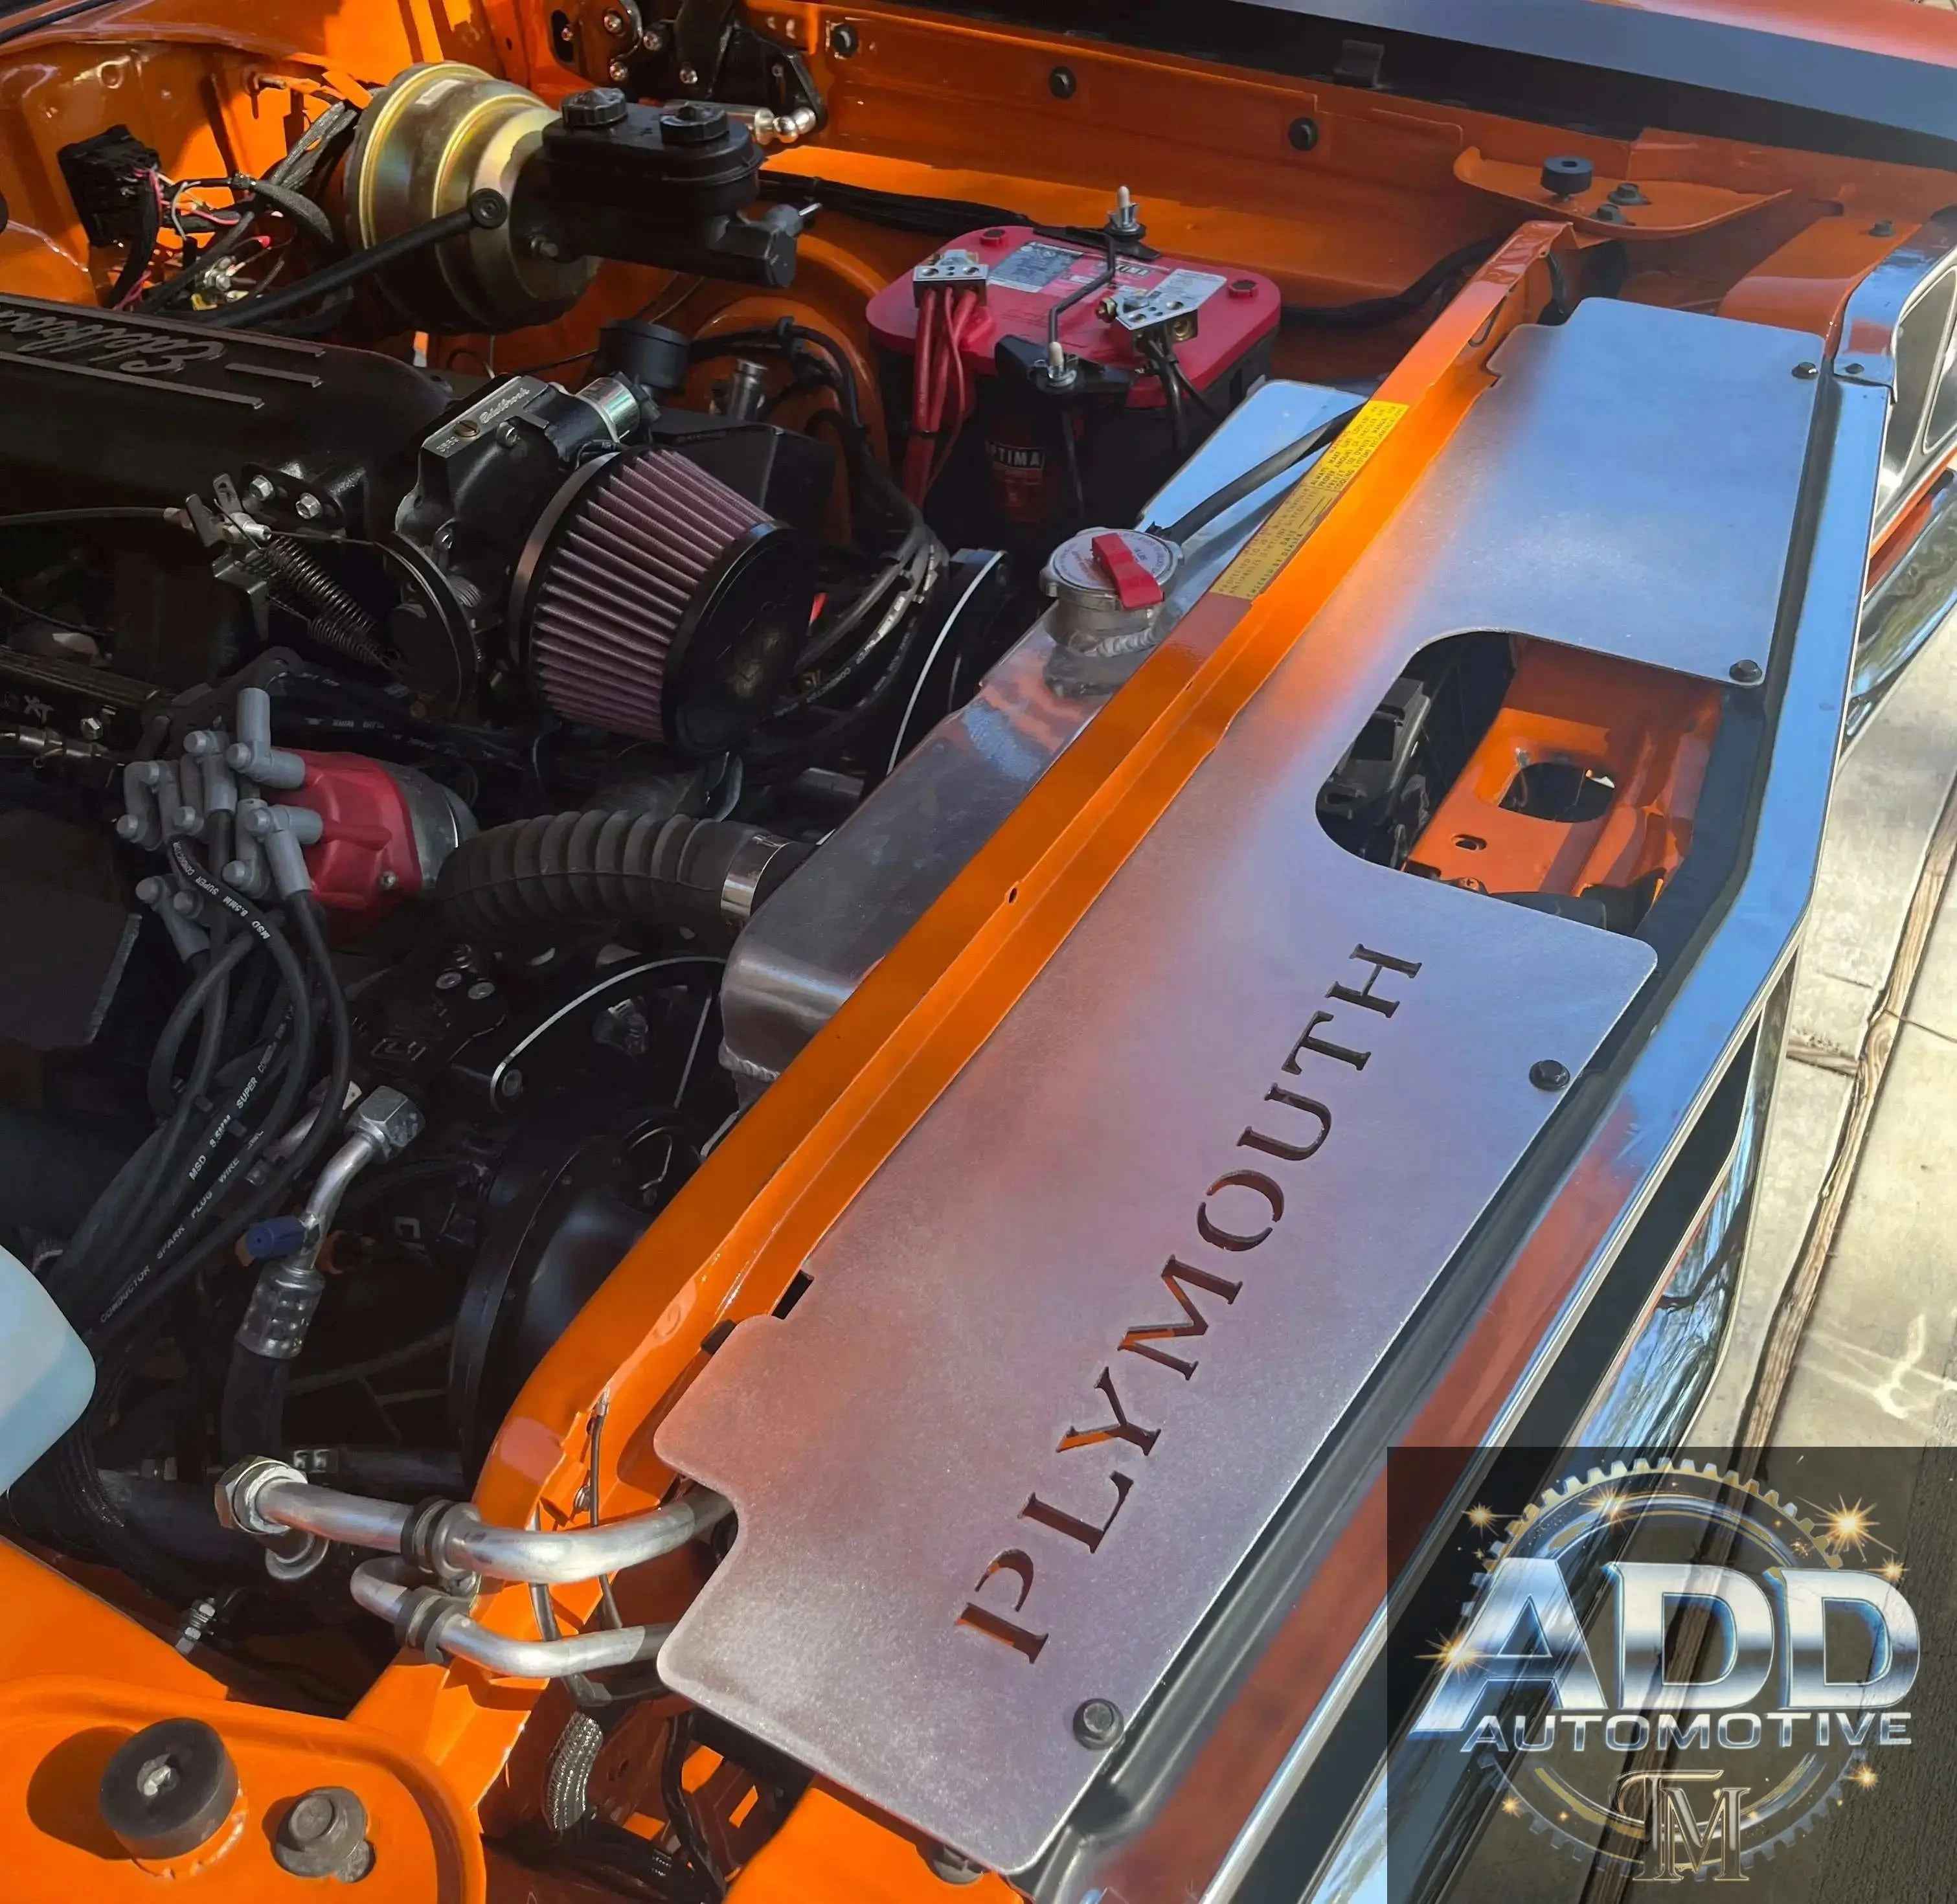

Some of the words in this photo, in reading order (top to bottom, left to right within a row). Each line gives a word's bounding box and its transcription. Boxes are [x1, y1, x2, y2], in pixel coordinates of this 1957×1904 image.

[194, 874, 220, 896] SUPER
[251, 919, 271, 941] MSD
[188, 1154, 208, 1182] MSD
[235, 1076, 258, 1110] SUPER
[99, 1264, 152, 1324] CONDUCTOR
[155, 1226, 186, 1261] SPARK
[190, 1190, 214, 1219] PLUG
[218, 1157, 242, 1184] WIRE
[955, 943, 1422, 1664] PLYMOUTH
